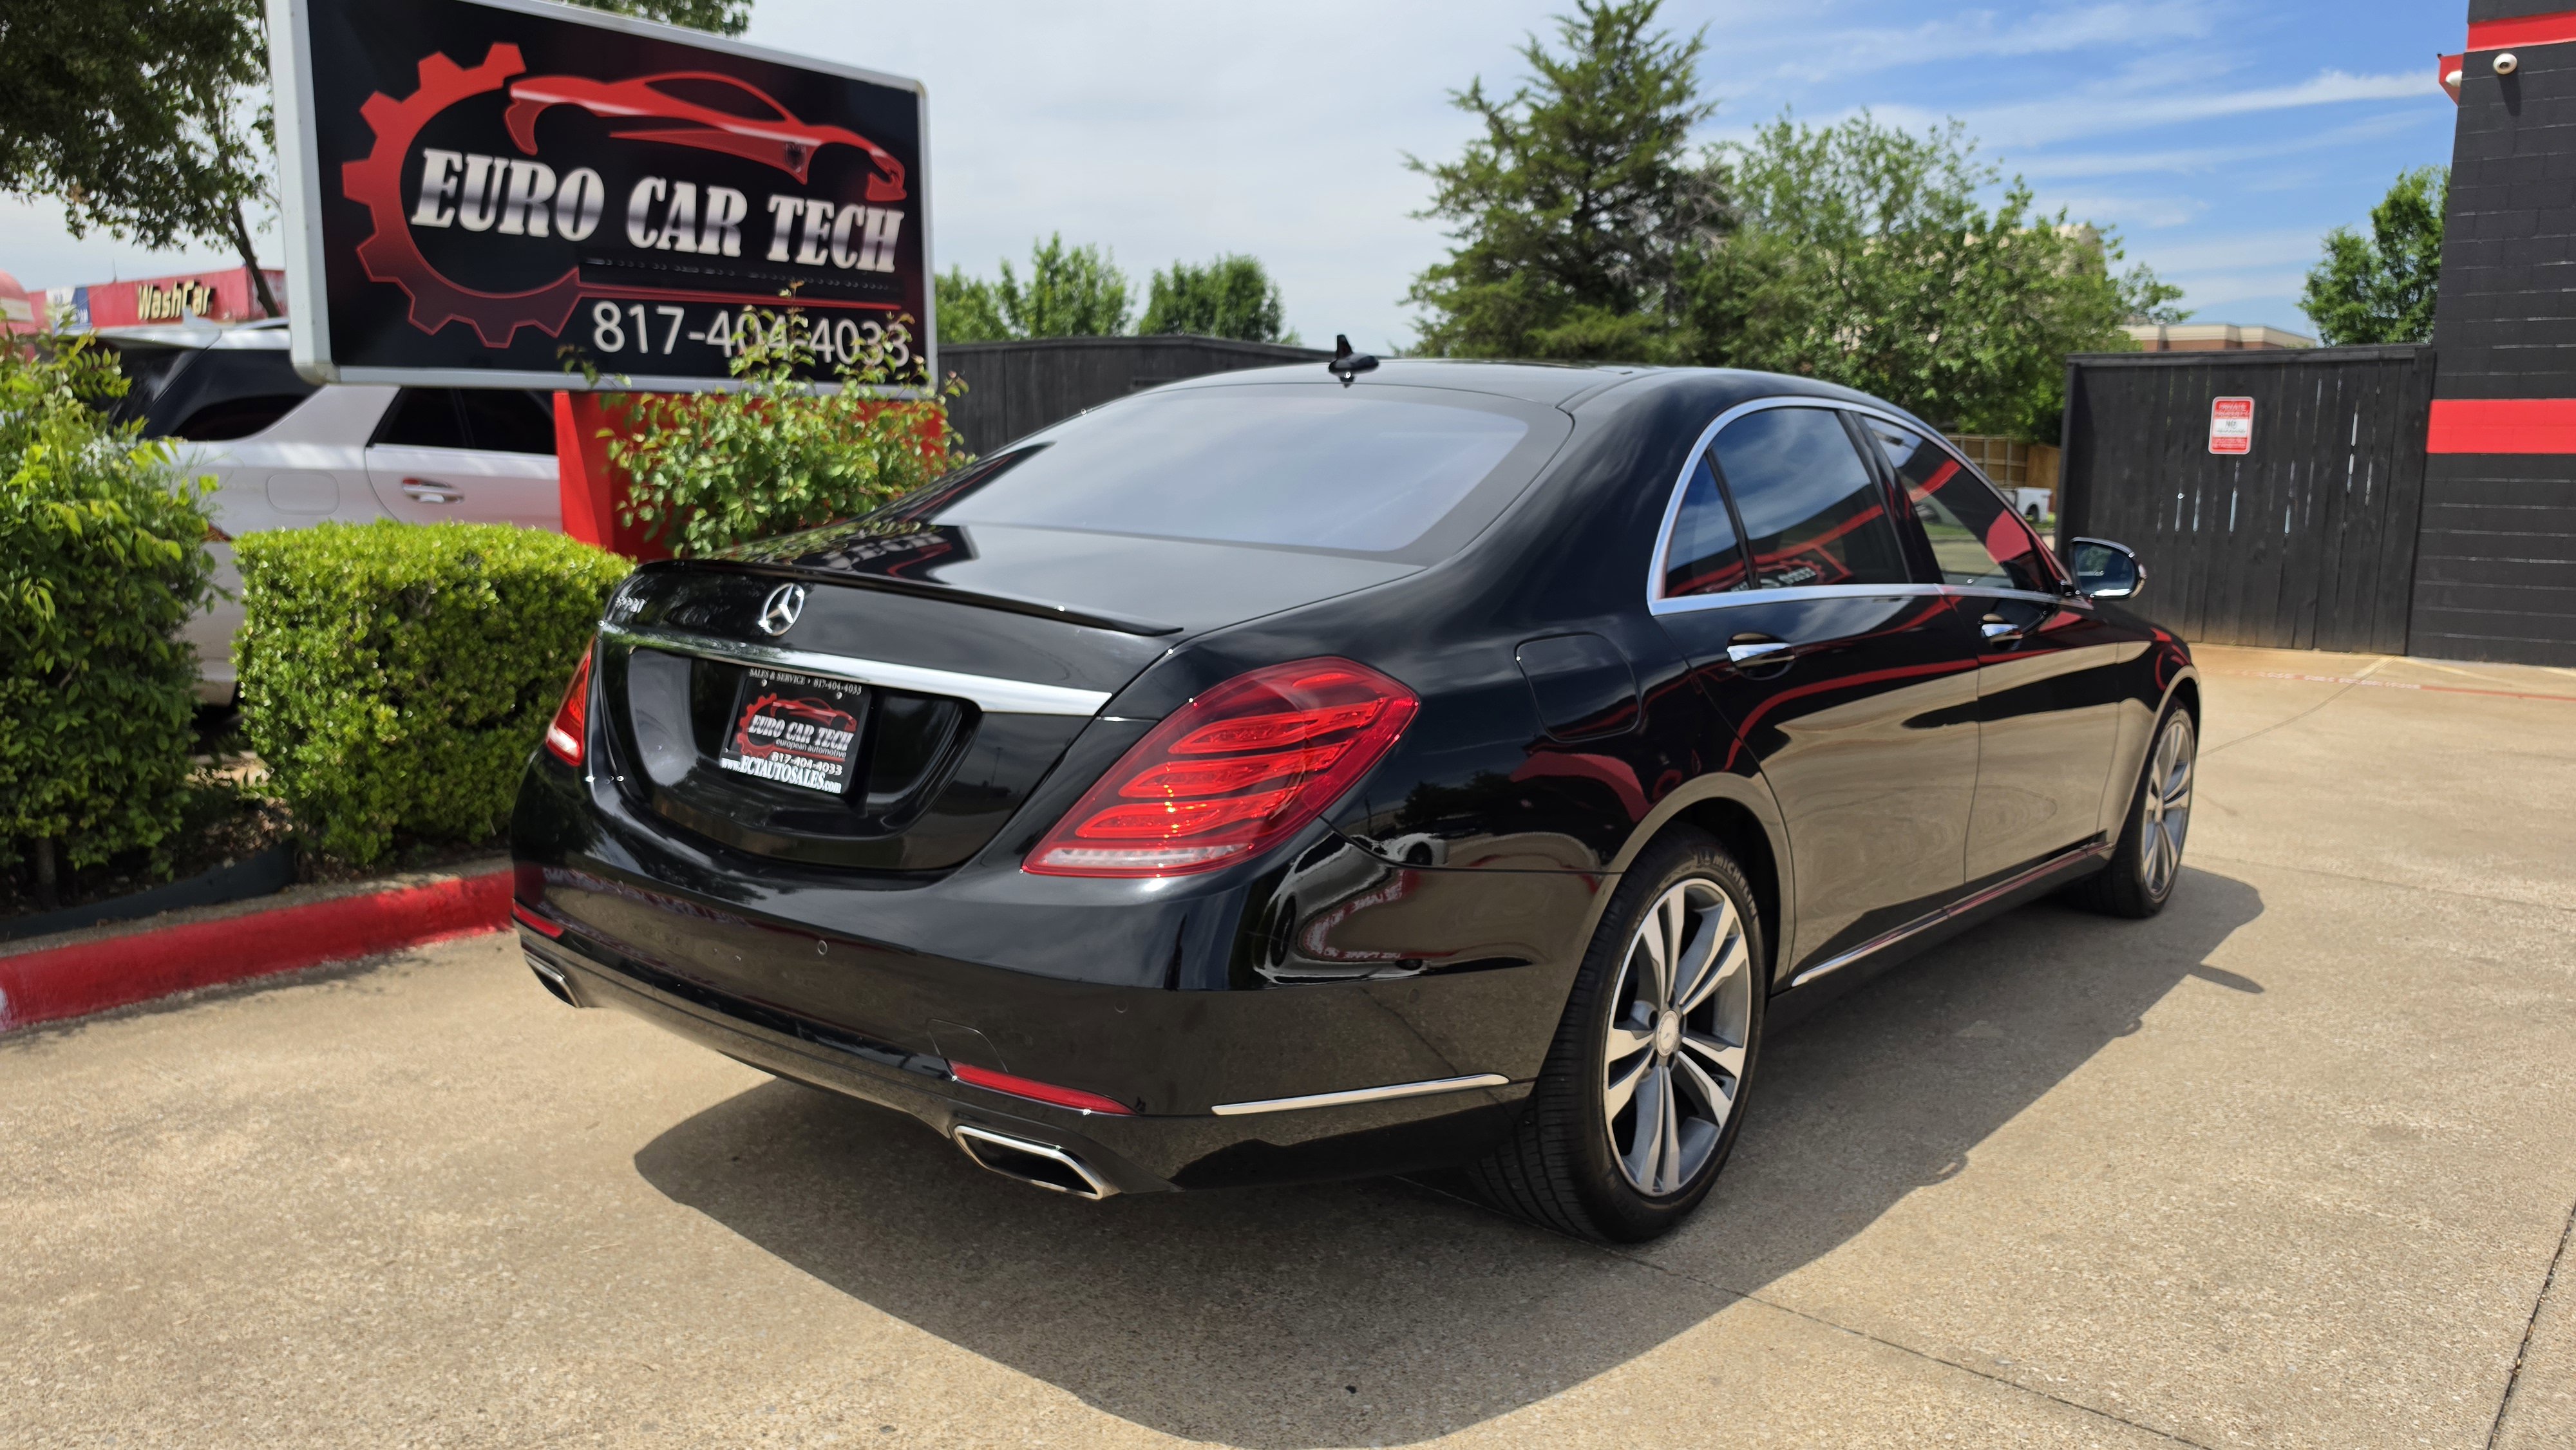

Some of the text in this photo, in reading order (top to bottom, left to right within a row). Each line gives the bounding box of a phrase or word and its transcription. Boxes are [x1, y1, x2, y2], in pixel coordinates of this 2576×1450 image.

[410, 148, 904, 272] EURO CAR TECH
[750, 668, 862, 695] SALES & SERVICE 817-404-4033
[748, 715, 854, 751] EURO CAR TECH
[775, 739, 847, 758] european automotive
[720, 755, 842, 794] www.ECTAUTOSALES.com
[772, 751, 843, 776] 817-404-4033
